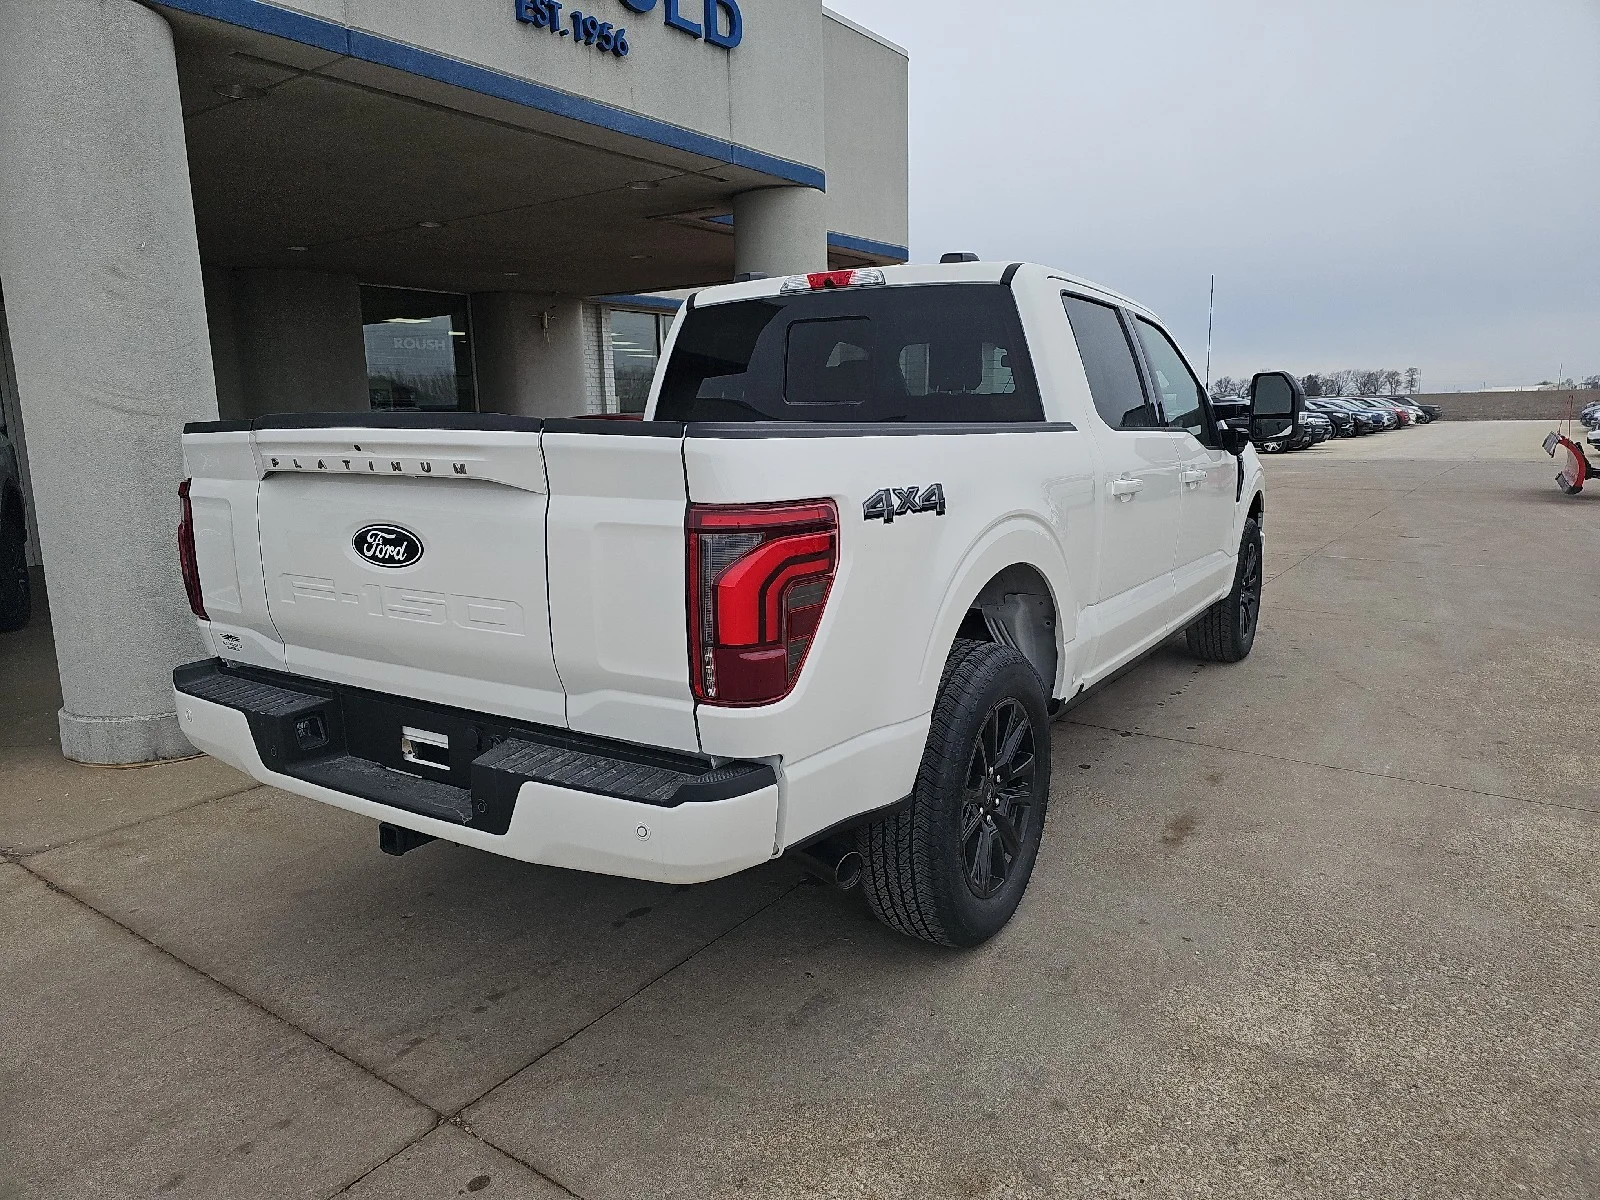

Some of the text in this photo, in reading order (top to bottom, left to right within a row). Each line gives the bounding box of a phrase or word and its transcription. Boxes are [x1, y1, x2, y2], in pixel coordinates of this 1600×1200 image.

[617, 0, 742, 49] LD
[393, 337, 446, 351] ROUSH
[270, 457, 468, 475] PLATINUM
[363, 530, 408, 561] Ford
[279, 573, 525, 636] F-150
